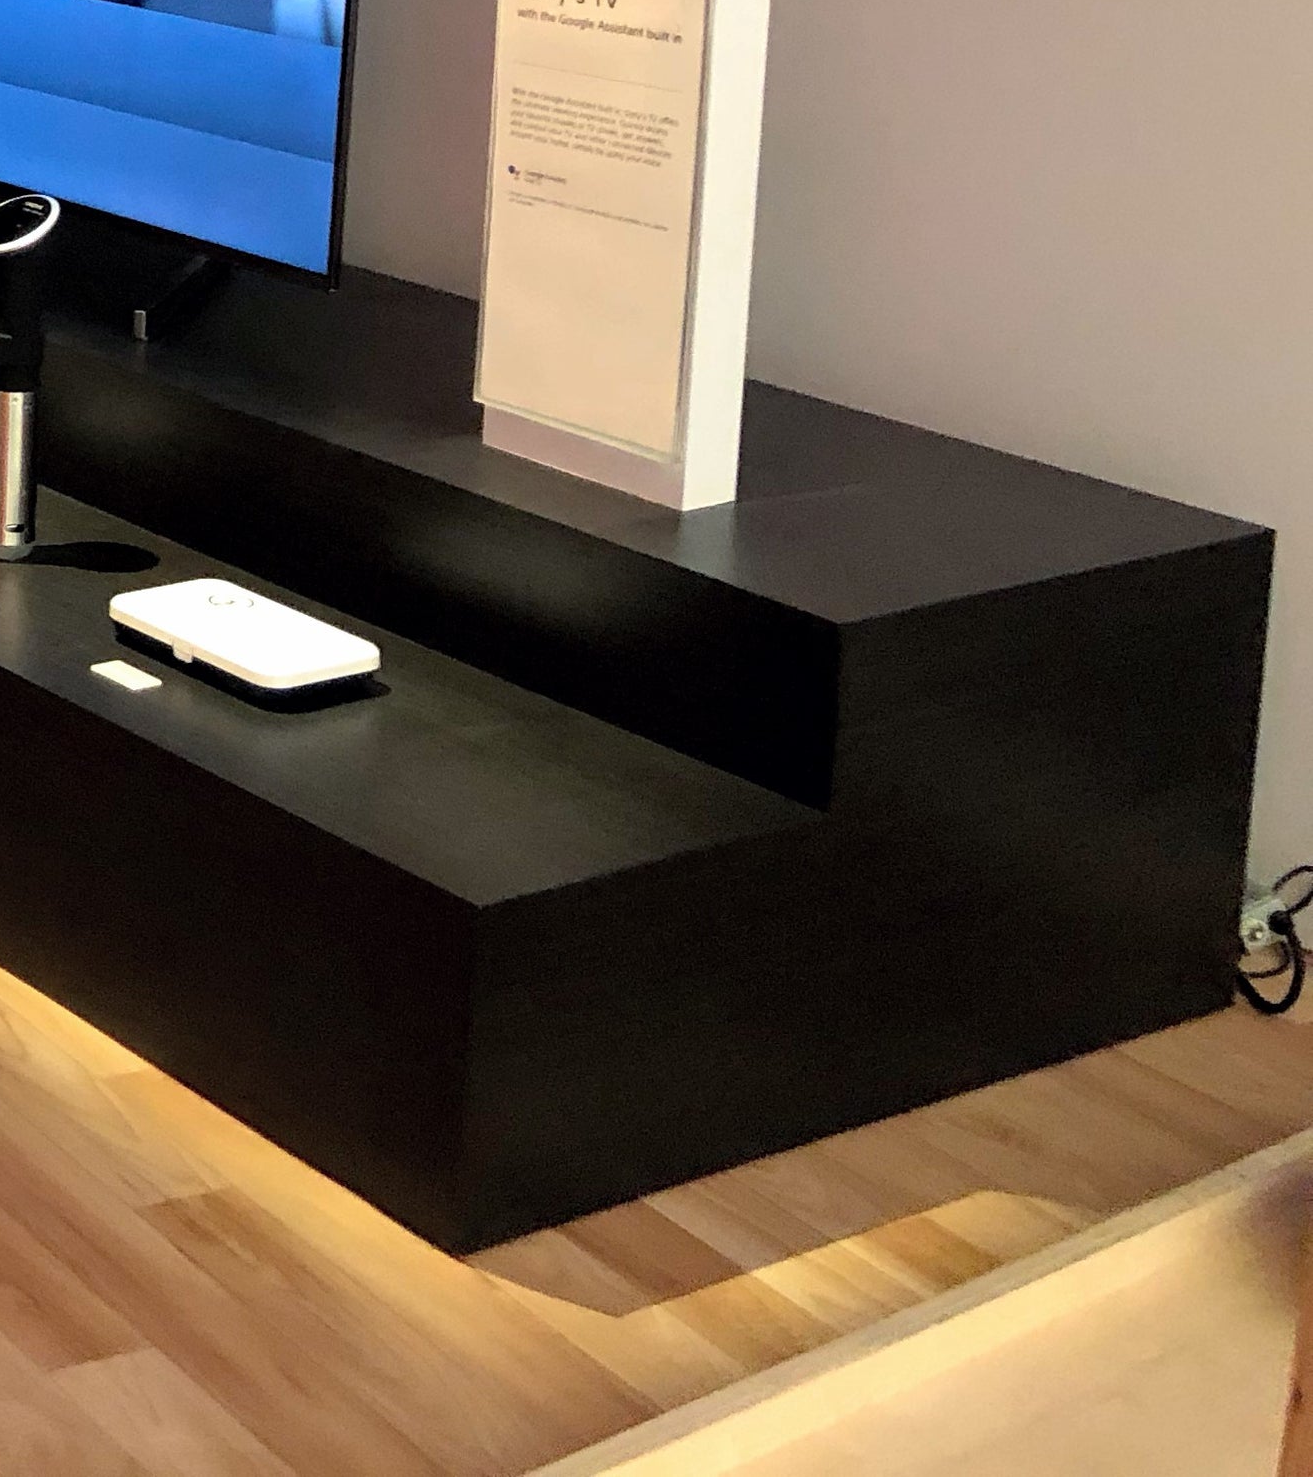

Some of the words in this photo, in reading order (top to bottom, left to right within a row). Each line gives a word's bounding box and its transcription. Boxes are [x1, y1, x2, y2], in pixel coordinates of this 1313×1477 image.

[517, 8, 539, 21] with
[540, 10, 557, 23] the
[558, 13, 594, 30] Google
[597, 20, 644, 37] Assistant
[645, 28, 670, 43] built
[672, 32, 683, 44] in
